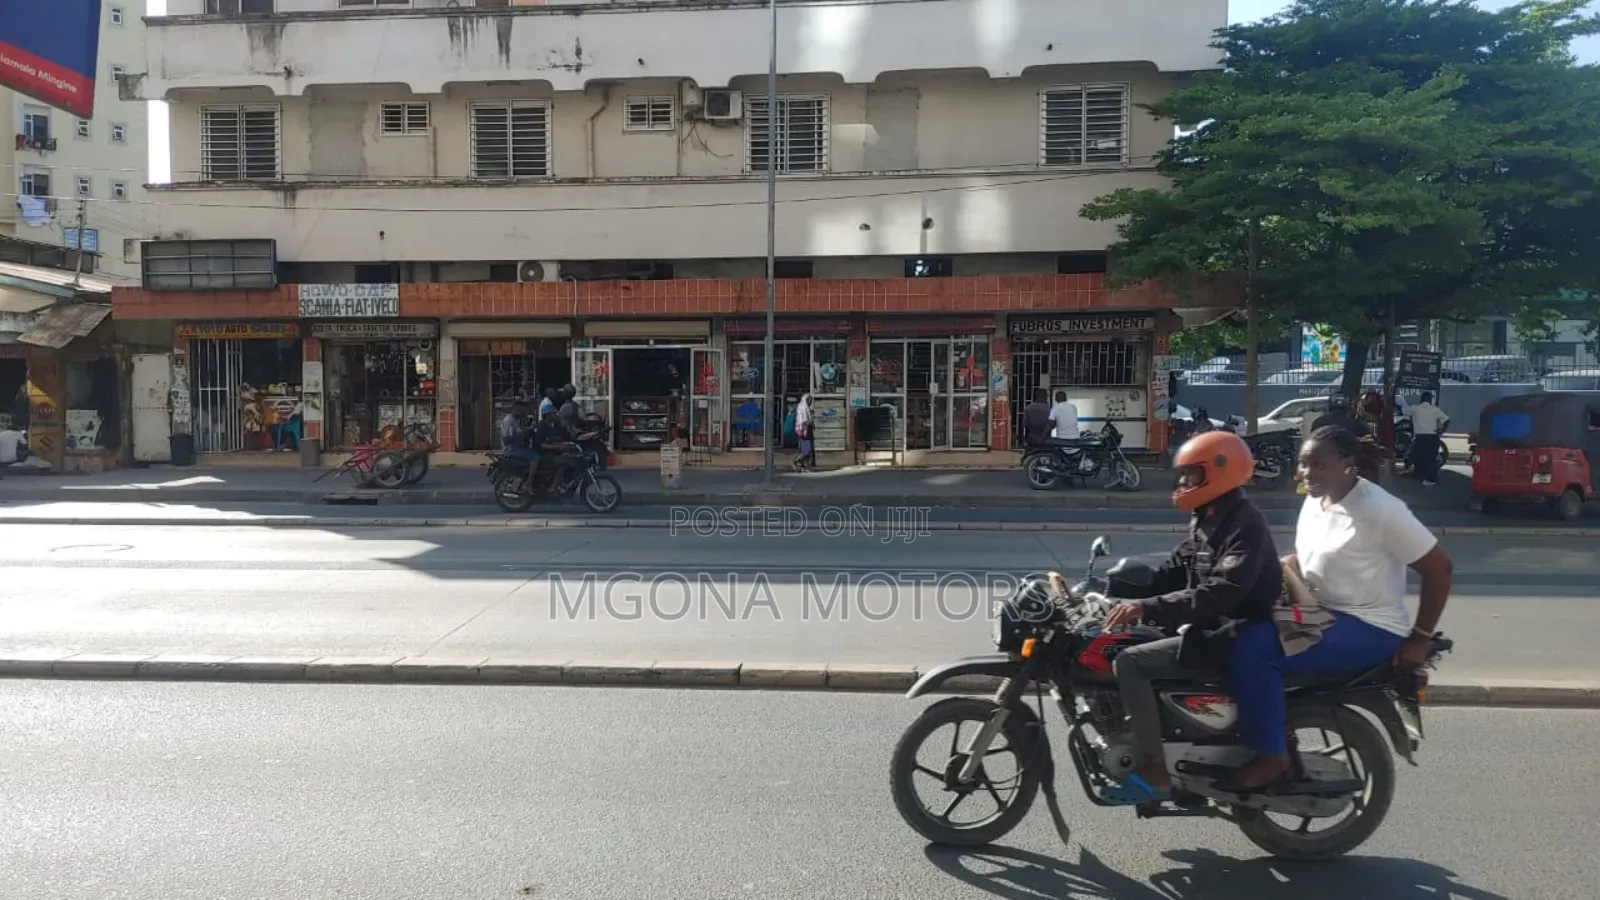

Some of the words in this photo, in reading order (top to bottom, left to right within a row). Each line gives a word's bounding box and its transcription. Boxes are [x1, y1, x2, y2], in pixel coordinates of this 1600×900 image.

[38, 69, 78, 93] Mingine
[225, 324, 247, 333] AUTO
[1069, 318, 1146, 330] INVESTMENT
